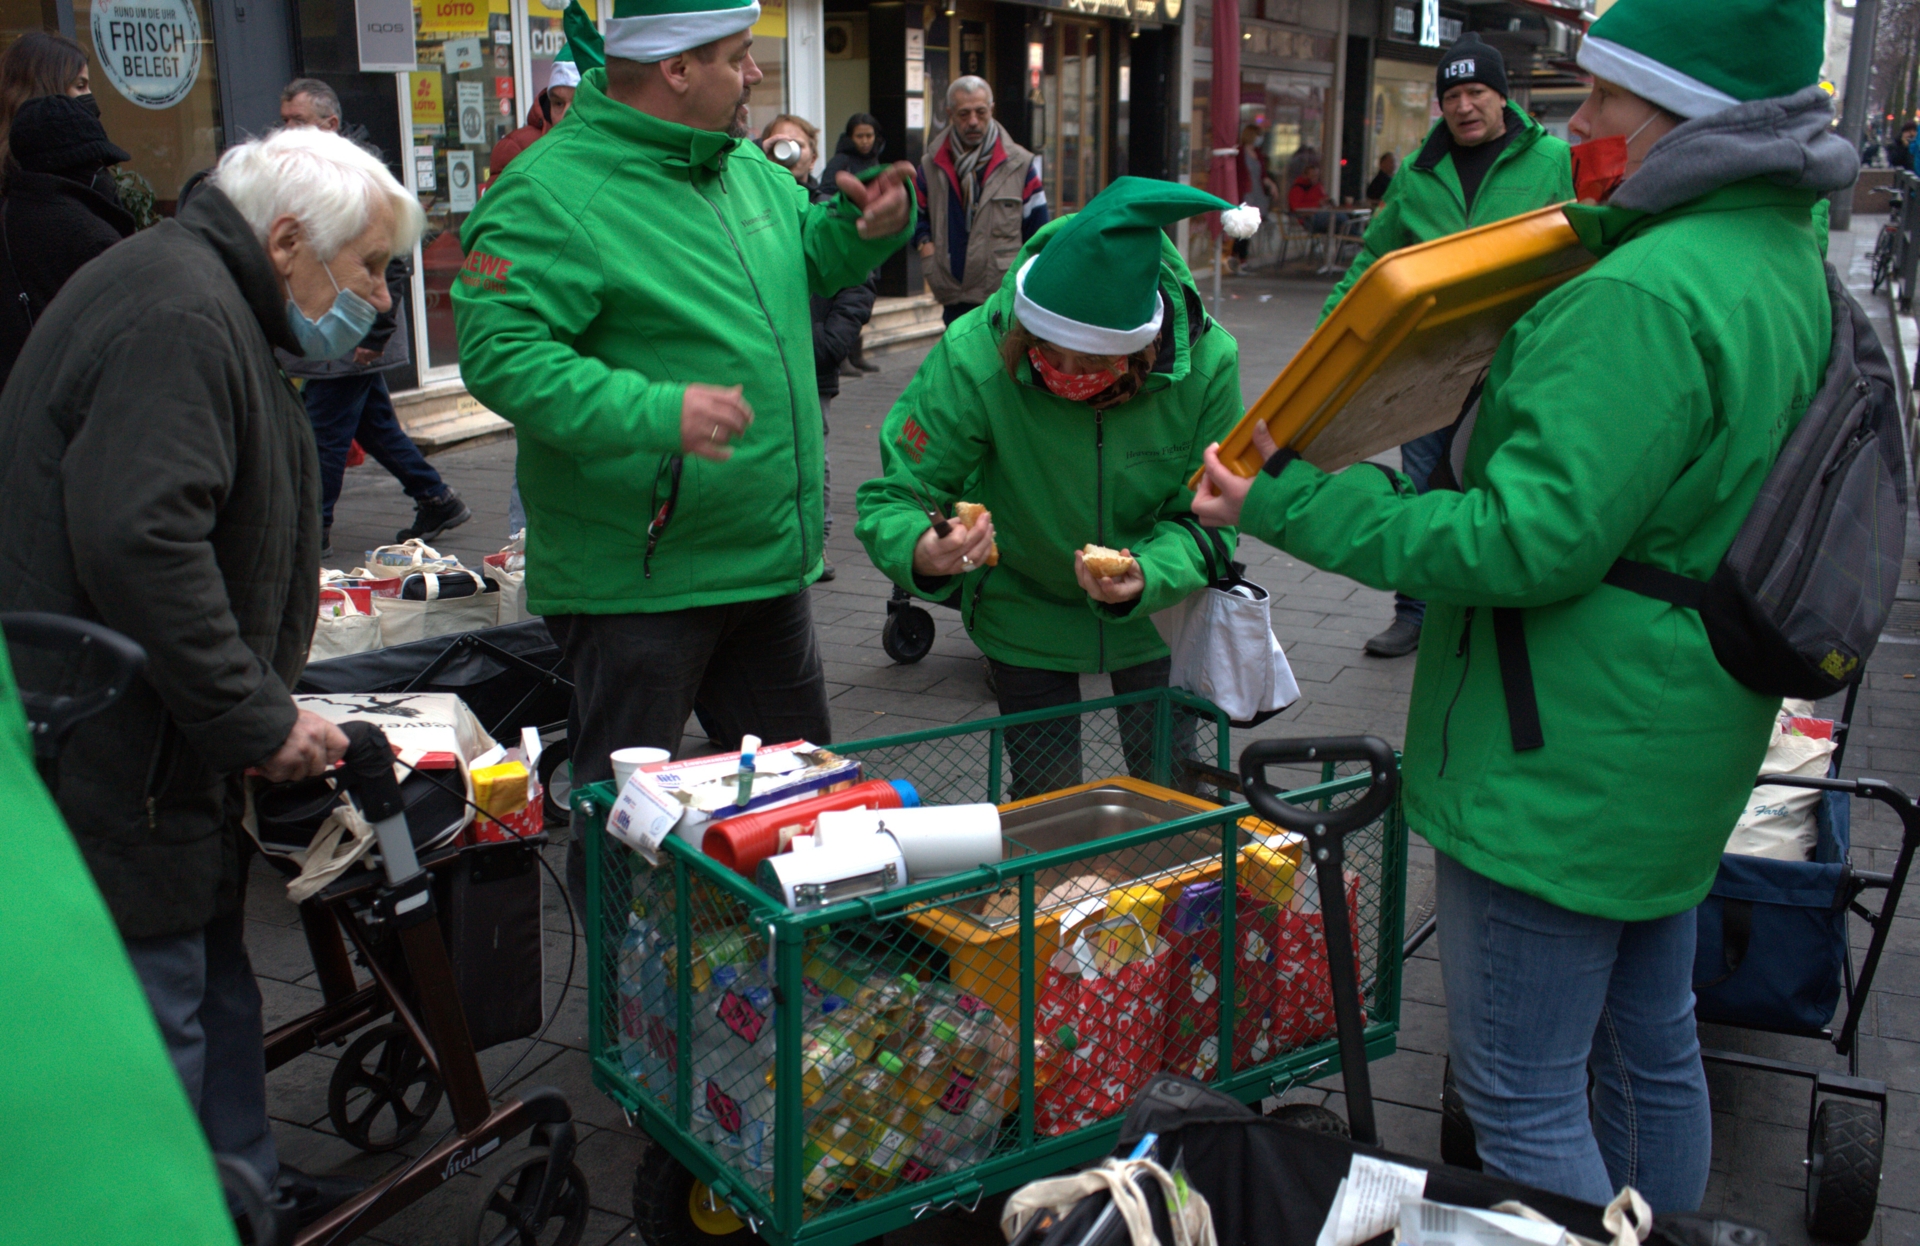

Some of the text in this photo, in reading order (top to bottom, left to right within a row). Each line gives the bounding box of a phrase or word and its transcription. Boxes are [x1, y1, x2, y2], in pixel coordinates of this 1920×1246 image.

[114, 6, 135, 18] RUND
[136, 7, 147, 19] UM
[149, 8, 160, 19] DIE
[162, 8, 176, 20] UHR
[437, 3, 475, 17] LOTTO
[367, 22, 404, 34] IQOS
[109, 21, 186, 53] FRISCH
[531, 29, 567, 55] COF
[123, 56, 180, 78] BELEGT
[1445, 61, 1476, 79] ICON
[413, 100, 437, 111] LOTTO
[903, 415, 930, 453] WE
[1754, 805, 1789, 817] Farbe
